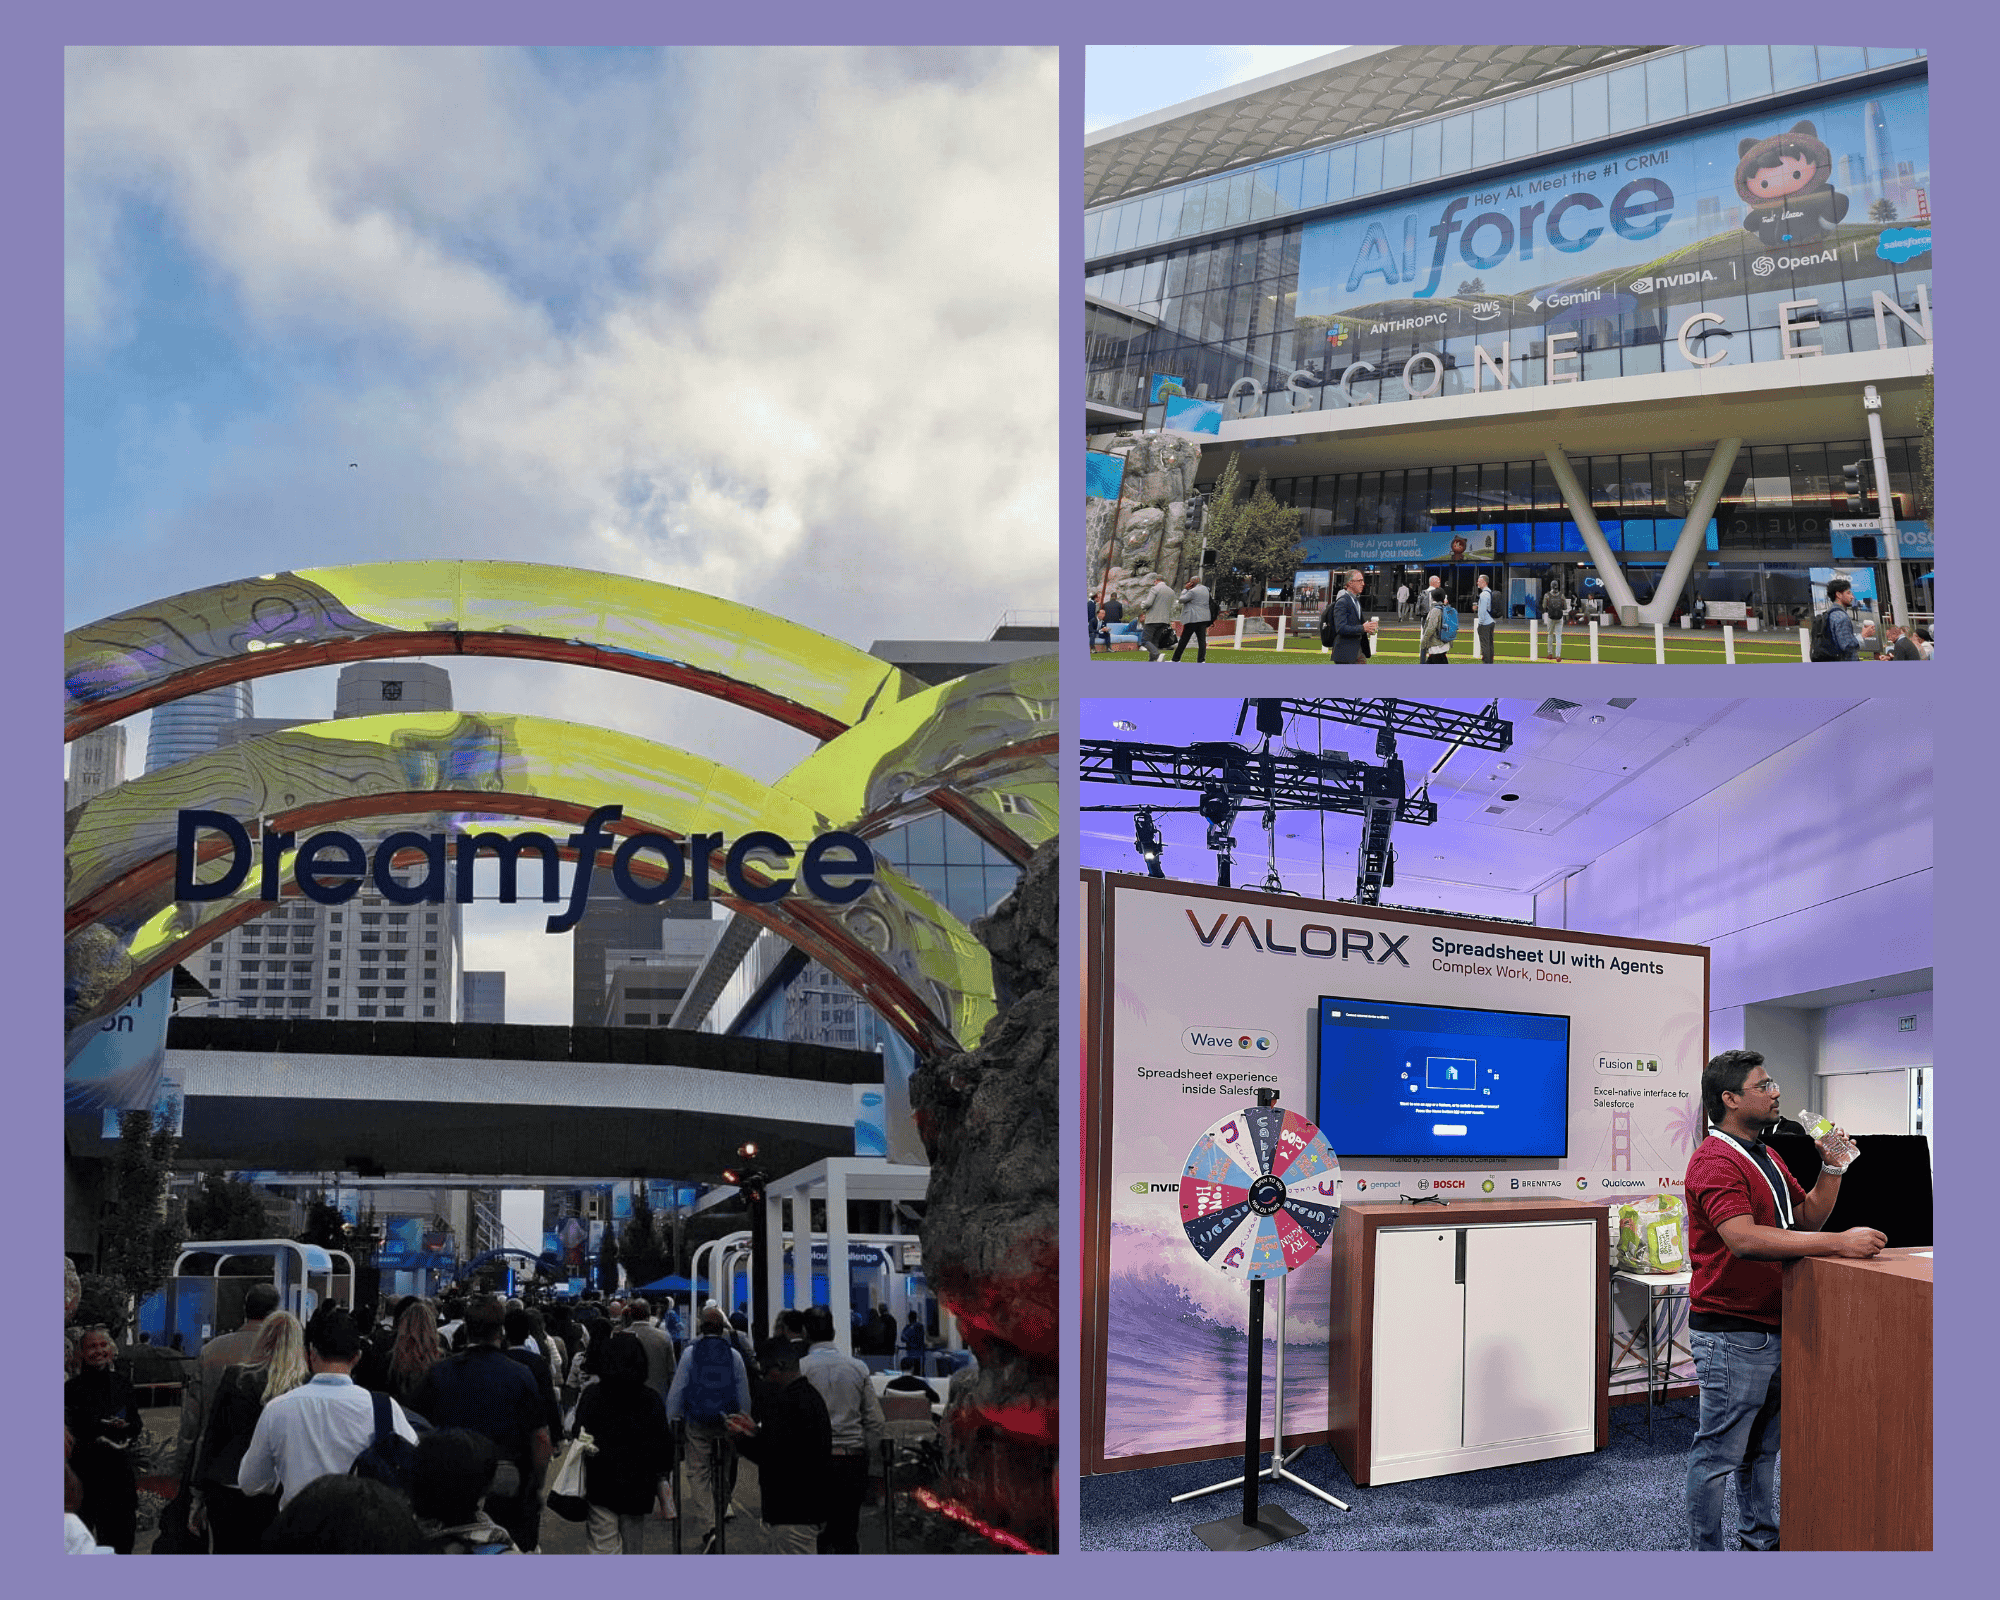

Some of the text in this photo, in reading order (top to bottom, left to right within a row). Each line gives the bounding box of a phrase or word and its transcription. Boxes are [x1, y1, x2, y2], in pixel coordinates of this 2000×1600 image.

[1474, 149, 1670, 207] Hey AI, Meet the #1 CRM!
[1883, 236, 1931, 249] salesforce
[1472, 299, 1501, 314] aws
[1546, 286, 1601, 309] Gemini
[1777, 249, 1838, 270] OpenAI
[1181, 284, 1932, 418] OSCONE CEN
[1350, 538, 1418, 549] The AI you want.
[1345, 550, 1361, 558] The
[1379, 550, 1396, 559] you
[1397, 549, 1423, 557] need.
[174, 804, 876, 933] Dreamforce
[1185, 908, 1410, 967] VALORX
[1432, 936, 1664, 975] Spreadsheet UI with Agents
[1432, 958, 1572, 984] Complex Work, Done.
[1190, 1032, 1233, 1048] Wave
[1599, 1057, 1633, 1070] Fusion
[1137, 1066, 1278, 1083] Spreadsheet experience
[1182, 1084, 1259, 1096] inside Salesfo
[1593, 1086, 1689, 1098] Excel-native interface for
[1593, 1098, 1635, 1108] Salesforce
[1281, 1129, 1307, 1150] OOPS
[1150, 1183, 1180, 1192] NVID
[1255, 1177, 1268, 1188] SPIN
[1370, 1181, 1400, 1189] genpact
[1433, 1180, 1465, 1189] BOSCH
[1601, 1178, 1646, 1188] Qualcomm
[1290, 1236, 1309, 1255] TRY
